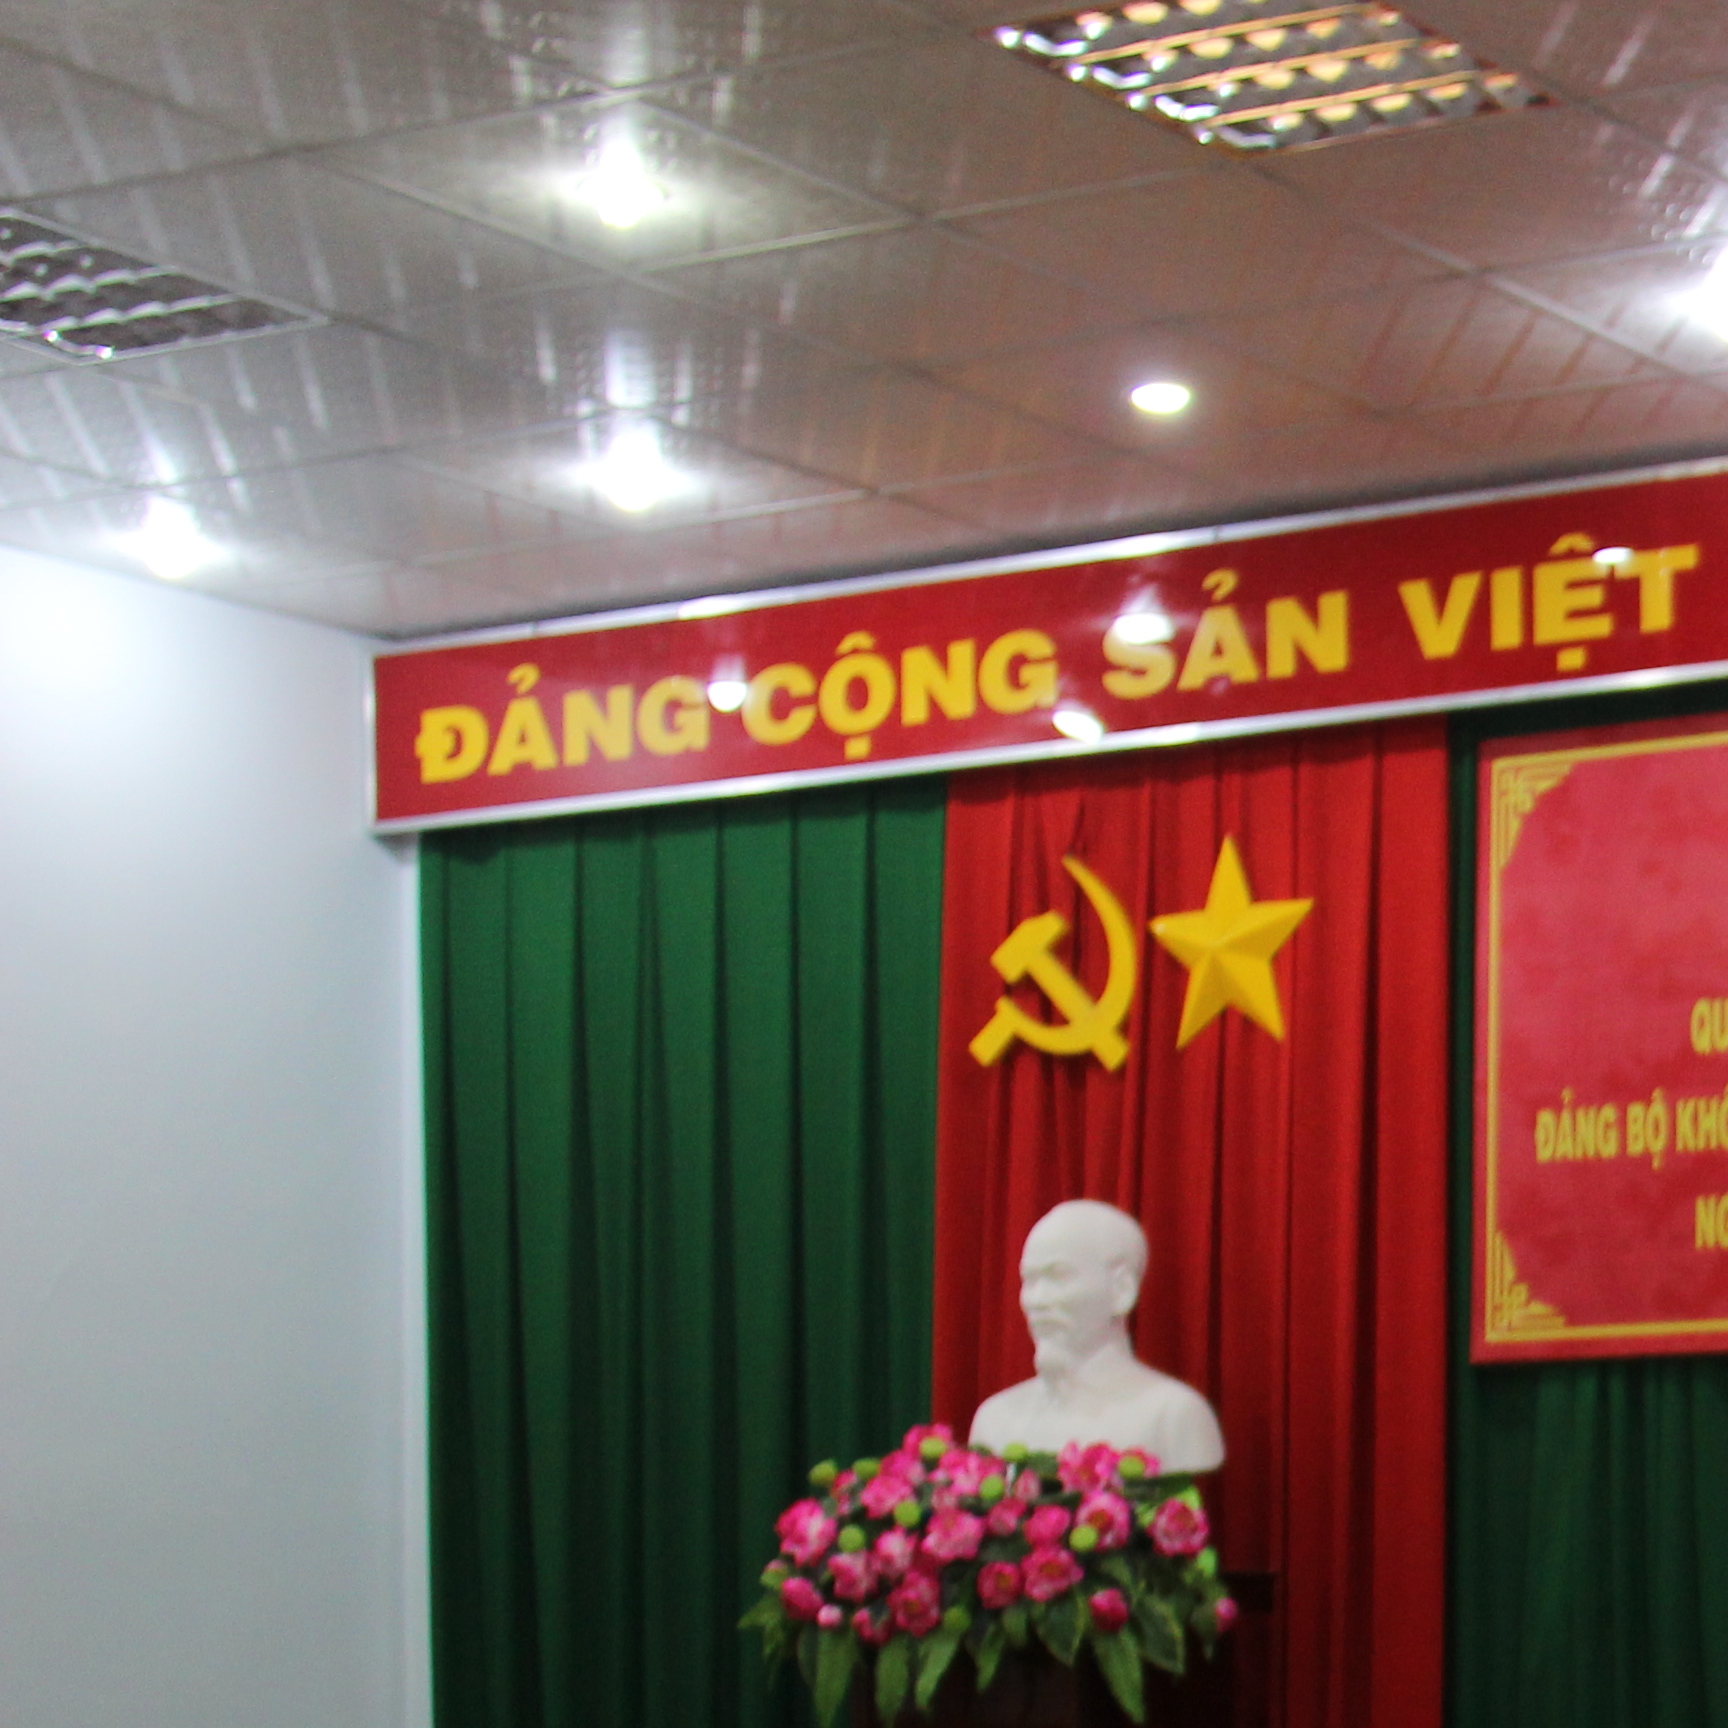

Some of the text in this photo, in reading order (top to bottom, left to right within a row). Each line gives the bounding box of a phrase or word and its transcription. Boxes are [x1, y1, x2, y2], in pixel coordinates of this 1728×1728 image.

[415, 663, 709, 784] ĐẢNG
[742, 628, 1058, 761] CỘNG
[1101, 568, 1351, 701] SẢN
[1399, 534, 1700, 670] VIỆT
[1534, 1086, 1619, 1163] ĐẢNG
[1626, 1086, 1668, 1170] BỘ
